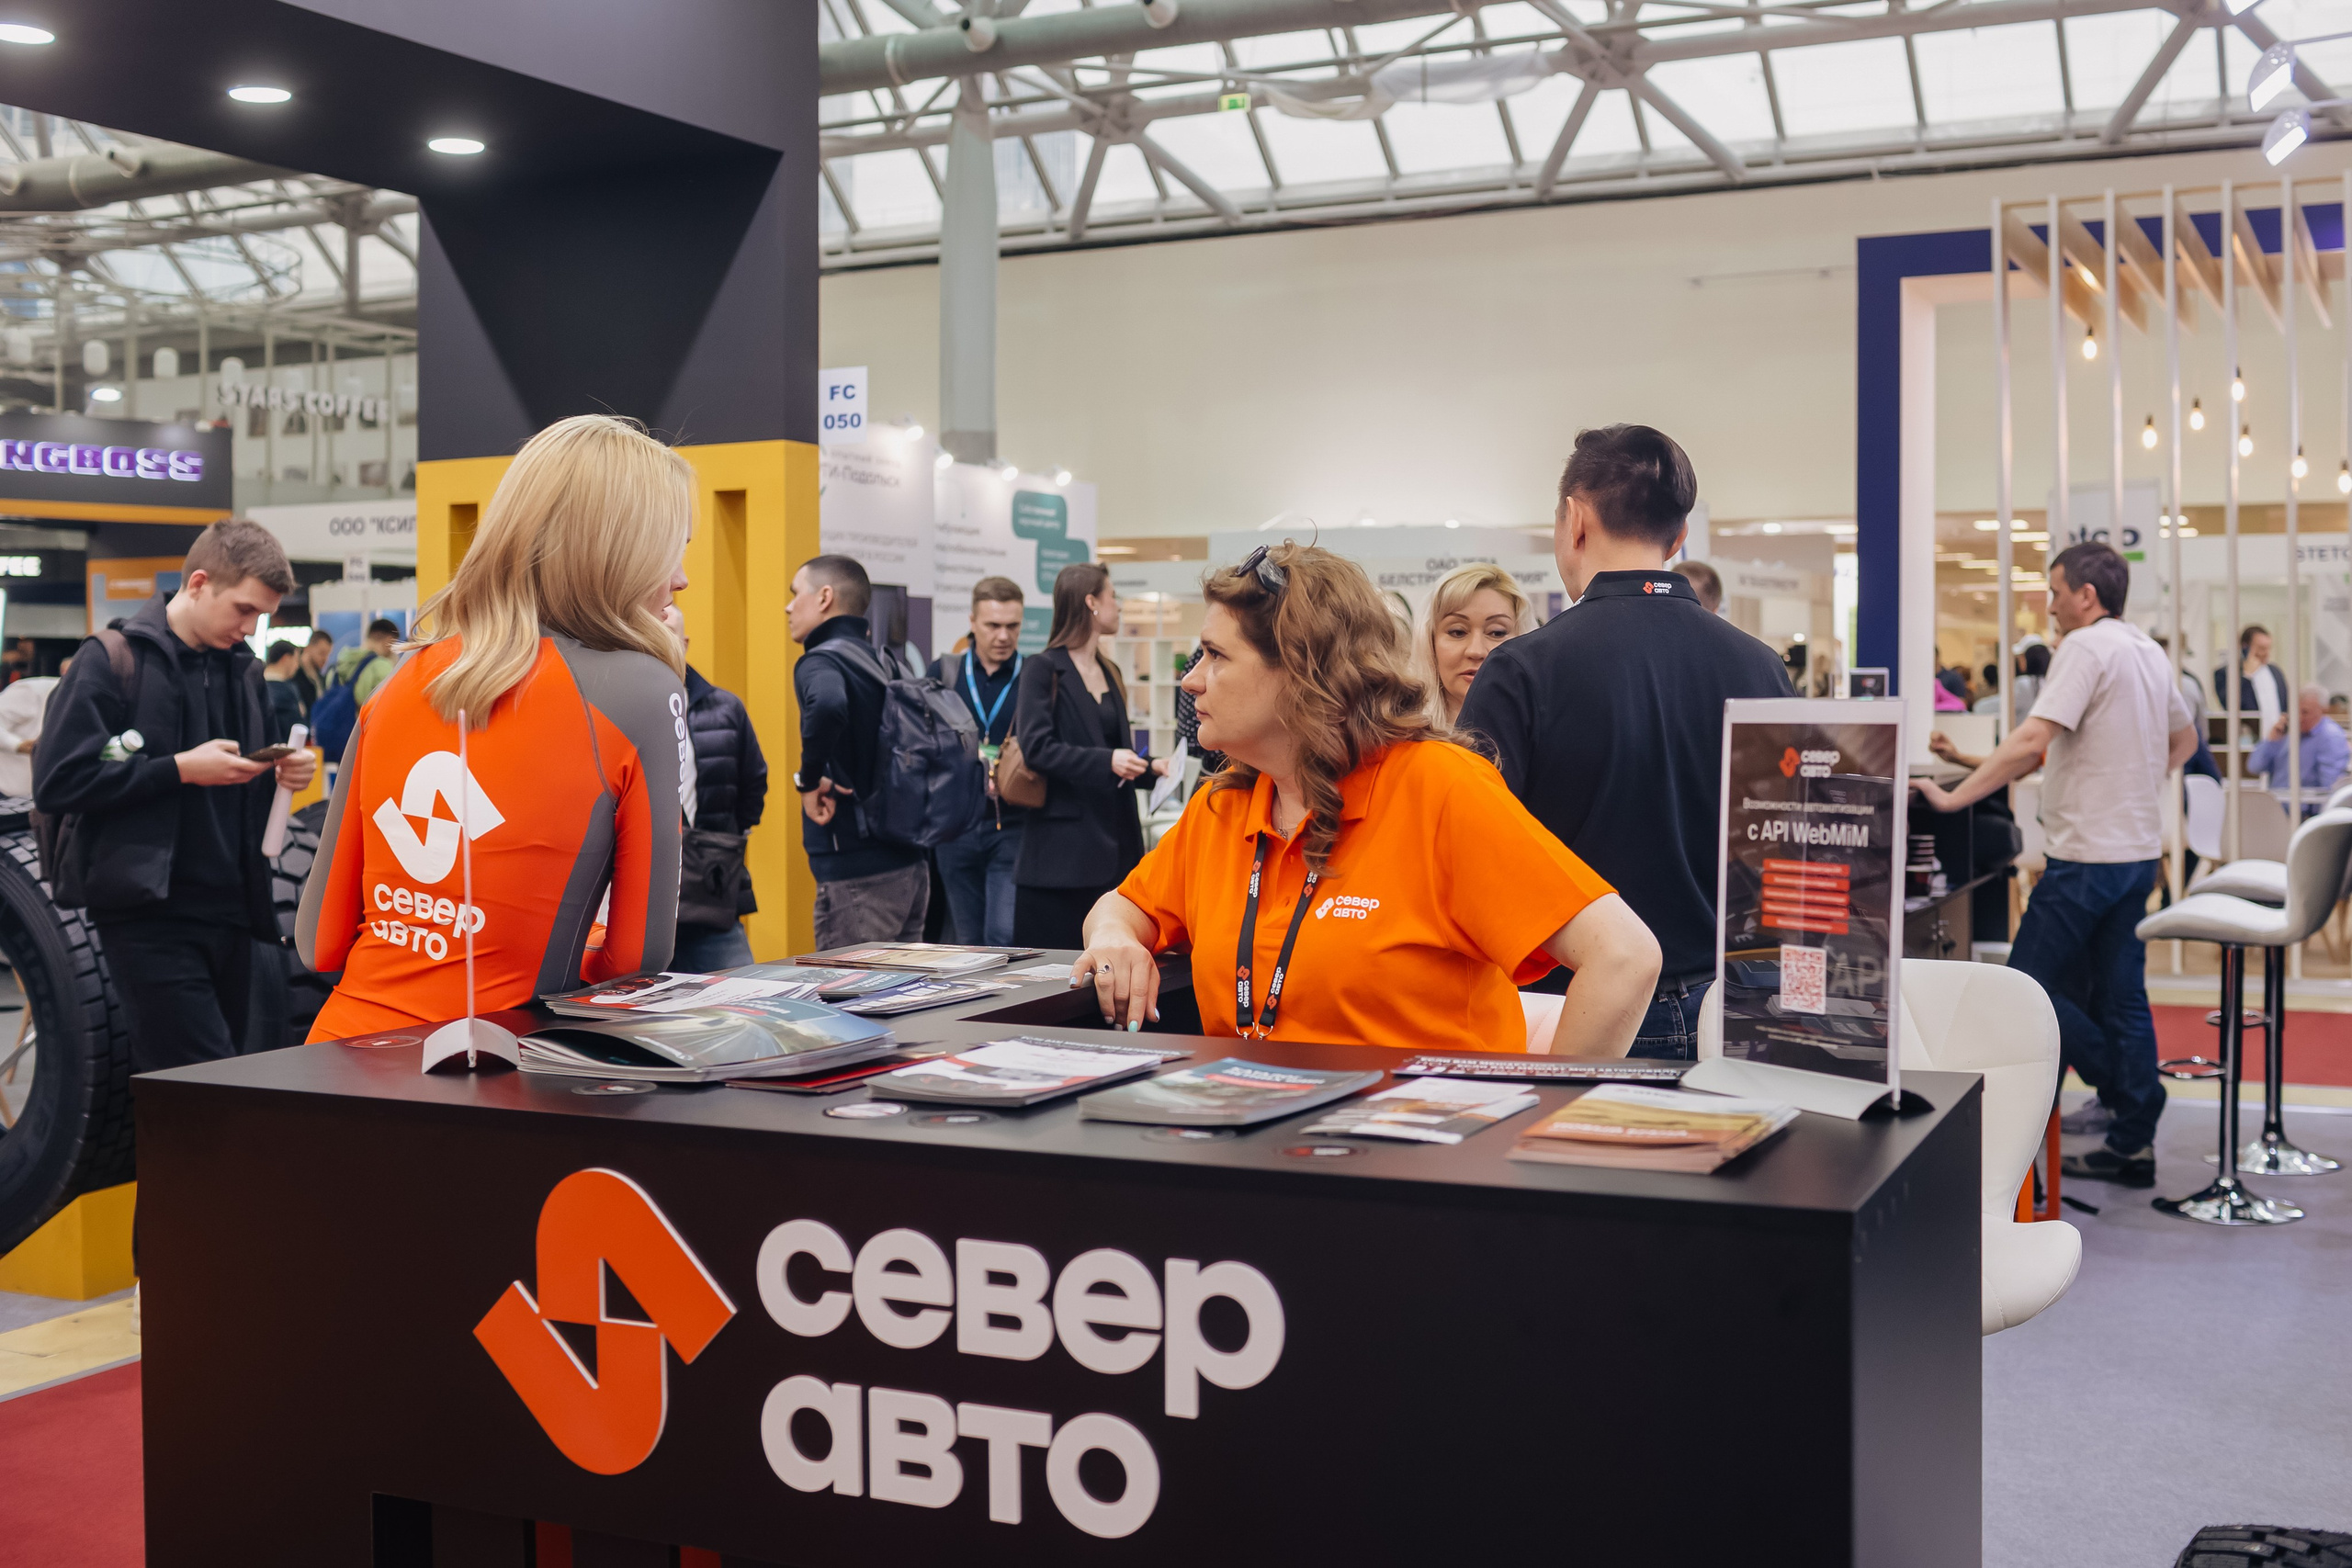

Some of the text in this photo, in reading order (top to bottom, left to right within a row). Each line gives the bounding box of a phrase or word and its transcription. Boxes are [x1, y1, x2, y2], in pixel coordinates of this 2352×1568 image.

[830, 384, 856, 400] FC
[823, 412, 862, 430] 050
[1760, 819, 1790, 842] API
[1792, 821, 1869, 847] WebMiM
[373, 883, 486, 940] север
[1332, 908, 1367, 919] авто
[1335, 896, 1380, 910] север
[756, 1218, 1286, 1419] север
[761, 1374, 1160, 1539] авто
